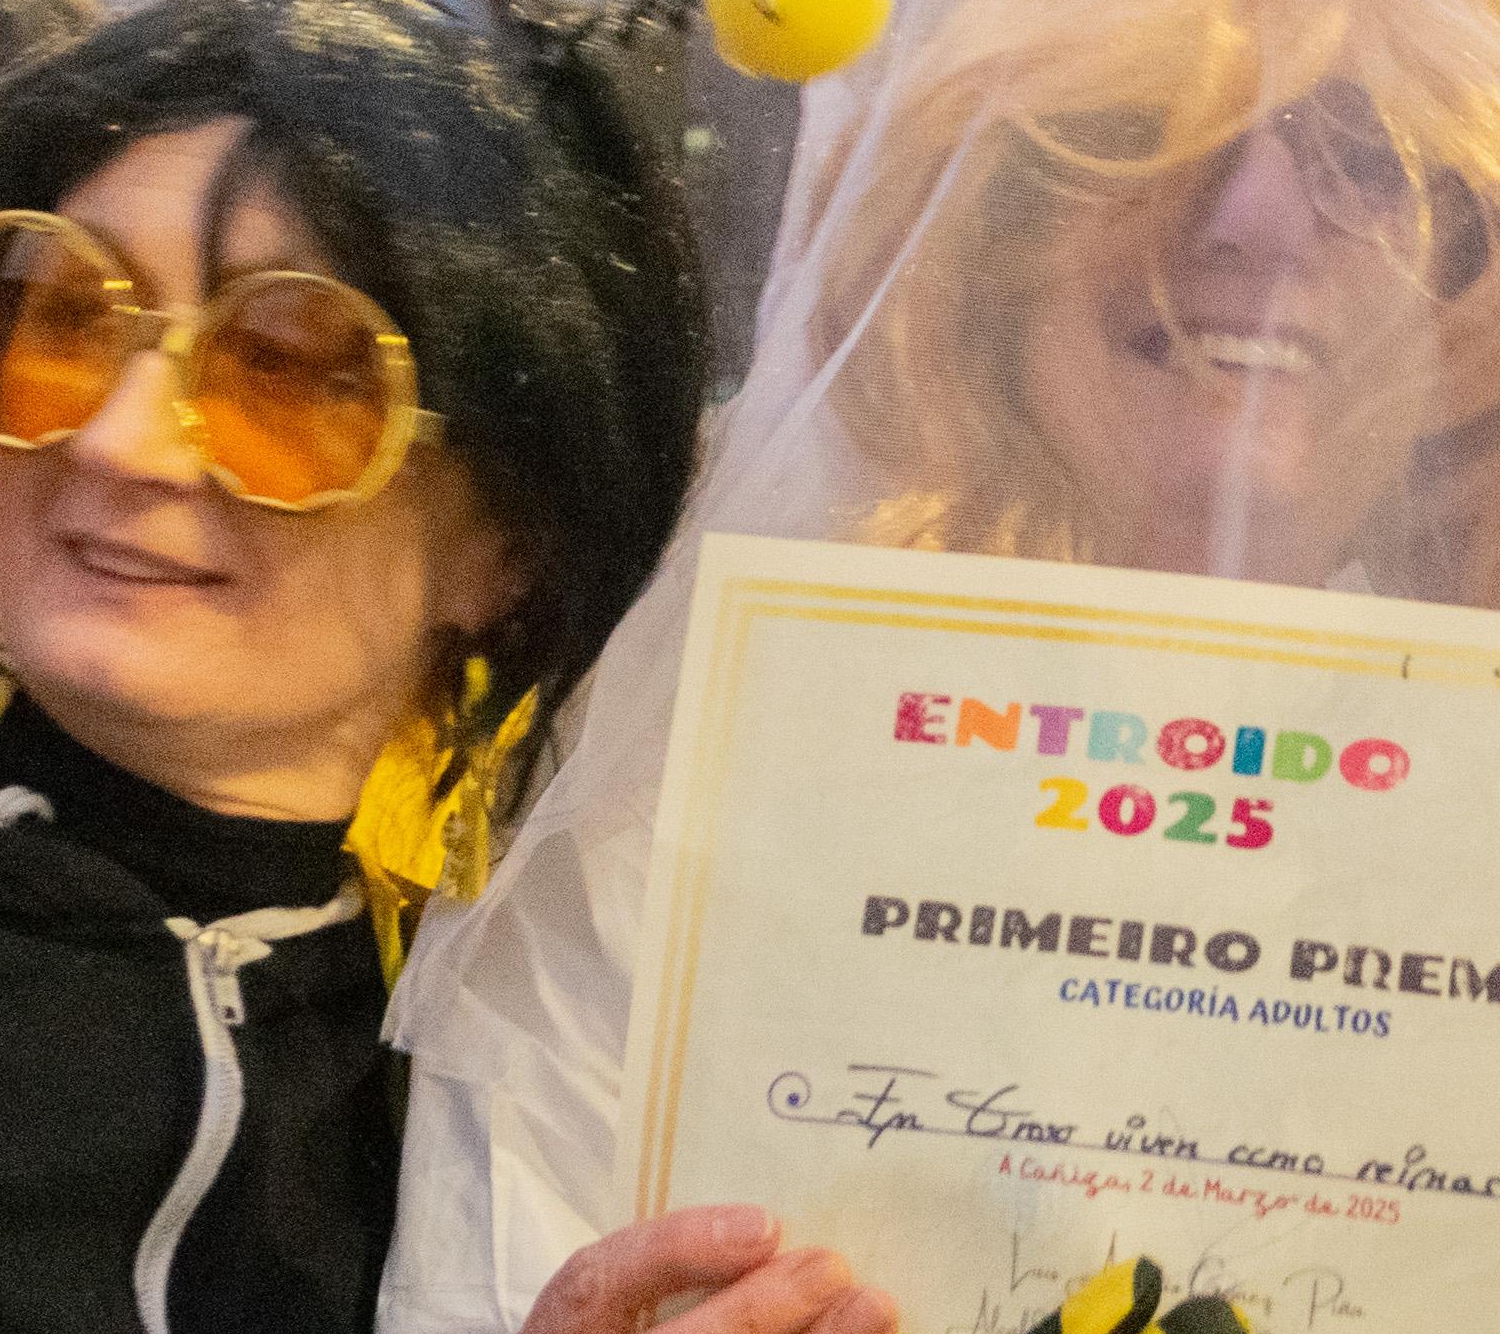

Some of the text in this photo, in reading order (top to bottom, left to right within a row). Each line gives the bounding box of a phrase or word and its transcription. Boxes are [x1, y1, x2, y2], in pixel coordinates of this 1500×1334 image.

[893, 691, 1411, 792] ENTROIDO
[1034, 777, 1275, 849] 2025
[861, 894, 1261, 974] PRIMEIRO
[1059, 978, 1393, 1039] CATEGORÍA ADULTOS
[1139, 1167, 1155, 1192] 2
[1162, 1175, 1197, 1199] de
[1304, 1193, 1340, 1217] de
[1346, 1194, 1401, 1225] 2025
